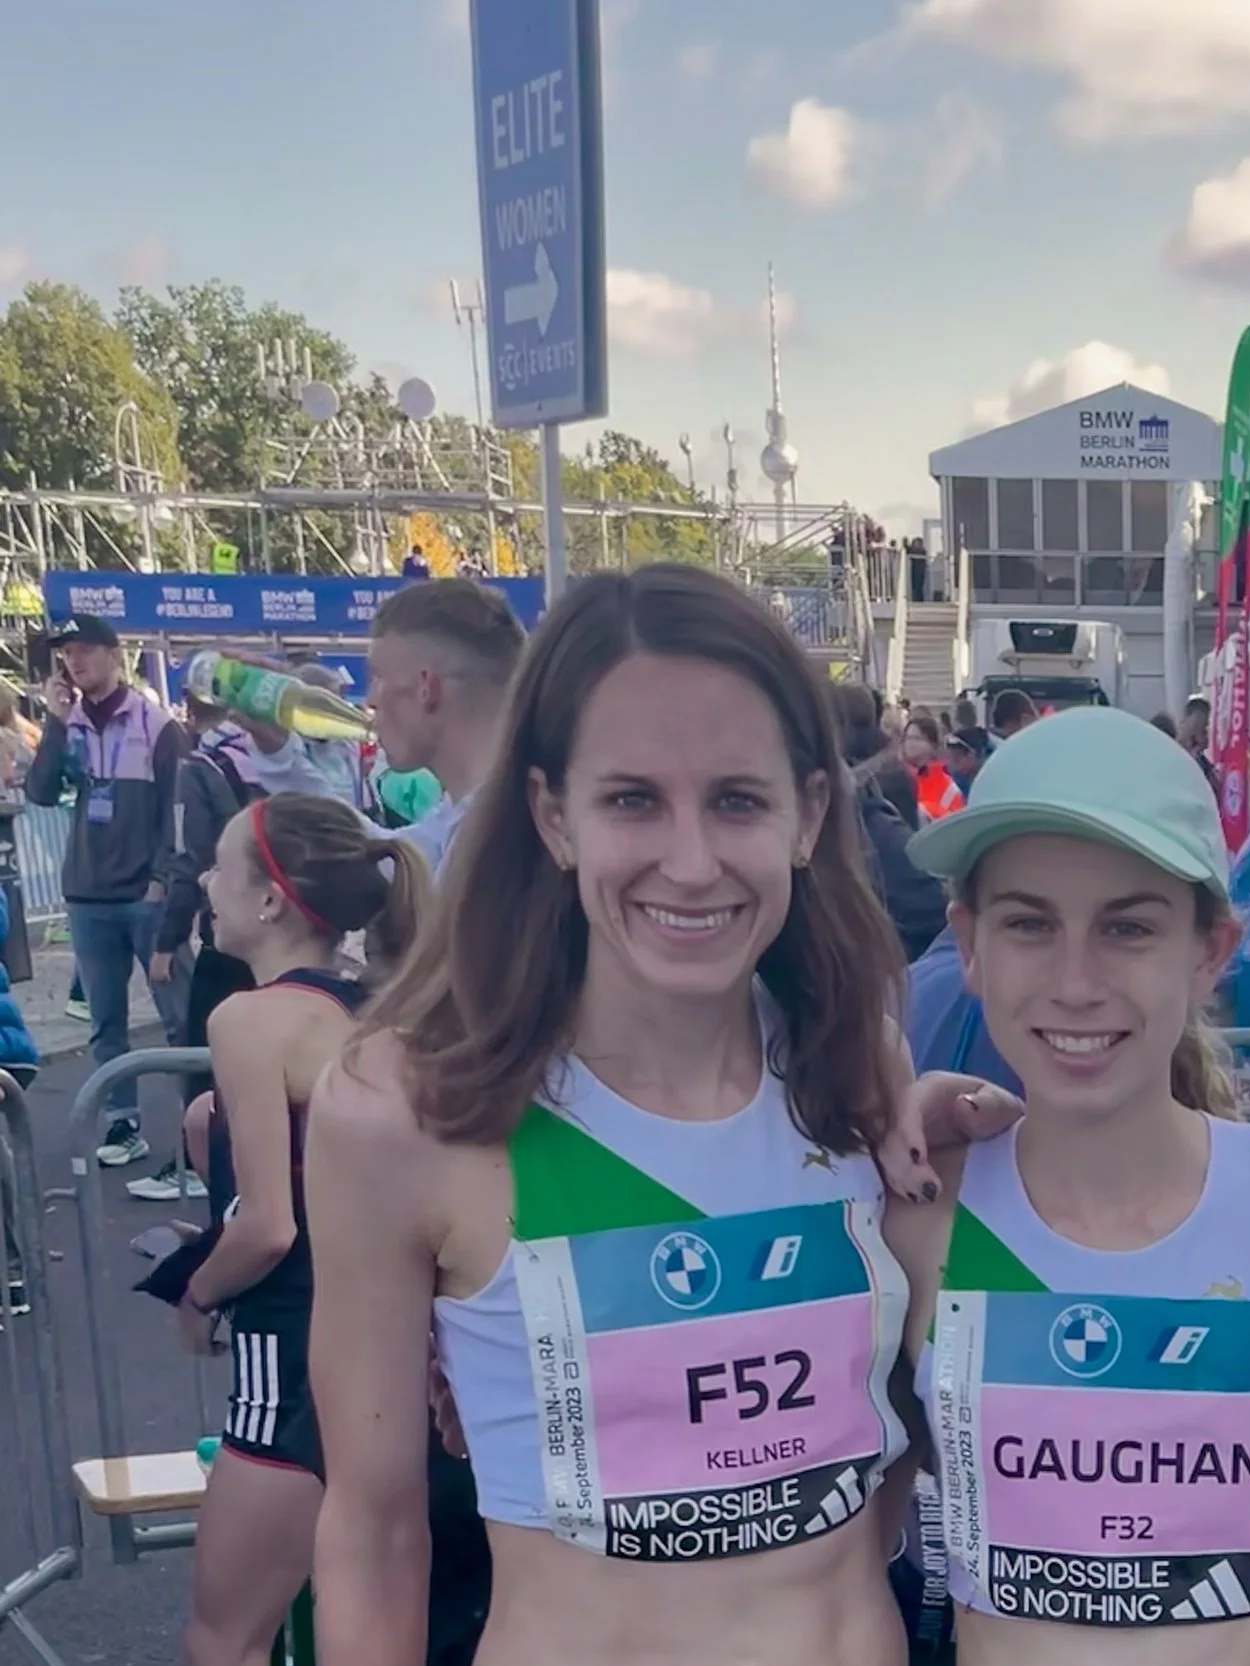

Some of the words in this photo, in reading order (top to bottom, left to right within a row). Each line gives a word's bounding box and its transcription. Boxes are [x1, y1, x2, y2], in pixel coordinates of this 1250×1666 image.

[492, 69, 565, 170] ELITE
[496, 184, 566, 250] WOMEN
[1080, 410, 1134, 429] BMW
[1080, 435, 1135, 449] BERLIN
[1080, 455, 1170, 469] MARATHON
[566, 1386, 583, 1423] 2023
[686, 1349, 815, 1424] F52
[570, 1425, 594, 1509] September
[706, 1437, 806, 1469] KELLNER
[959, 1430, 974, 1469] 2023
[610, 1478, 801, 1530] IMPOSSIBLE
[966, 1469, 982, 1551] September
[612, 1531, 642, 1556] IS
[650, 1514, 797, 1556] NOTHING
[951, 1504, 963, 1547] BMW
[1100, 1516, 1154, 1540] F32
[922, 1544, 947, 1576] JOY
[967, 1553, 980, 1579] 24.
[993, 1550, 1170, 1589] IMPOSSIBLE
[922, 1577, 947, 1606] FOR
[993, 1583, 1018, 1611] IS
[1023, 1587, 1163, 1622] NOTHING
